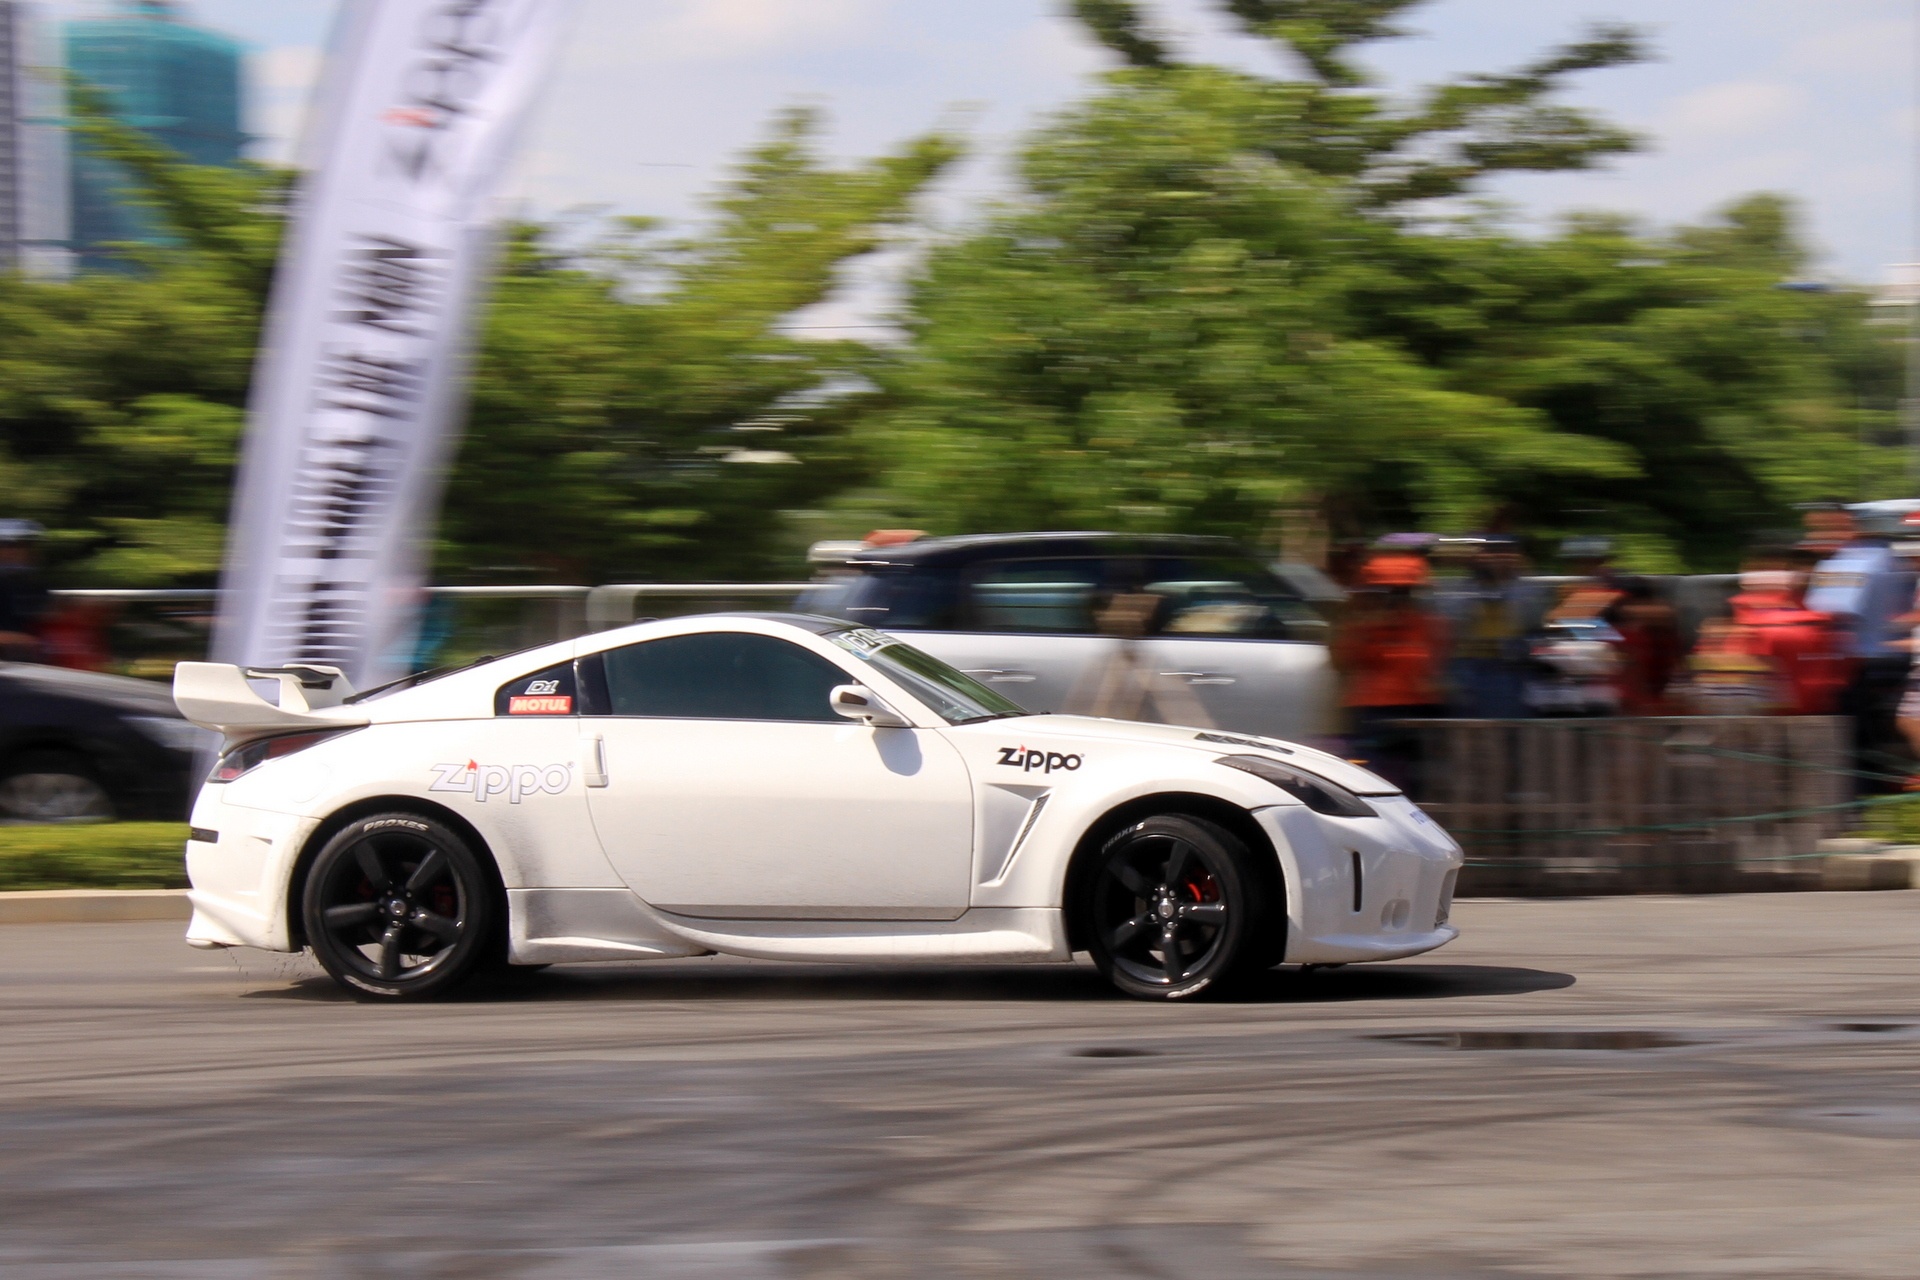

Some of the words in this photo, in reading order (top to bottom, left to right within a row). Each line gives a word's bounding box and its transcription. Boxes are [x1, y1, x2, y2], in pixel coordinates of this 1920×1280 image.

[524, 680, 560, 695] D1
[511, 698, 569, 711] MOTUL
[996, 744, 1082, 774] Zippo
[428, 759, 572, 804] Zippo
[363, 819, 430, 833] PROXES
